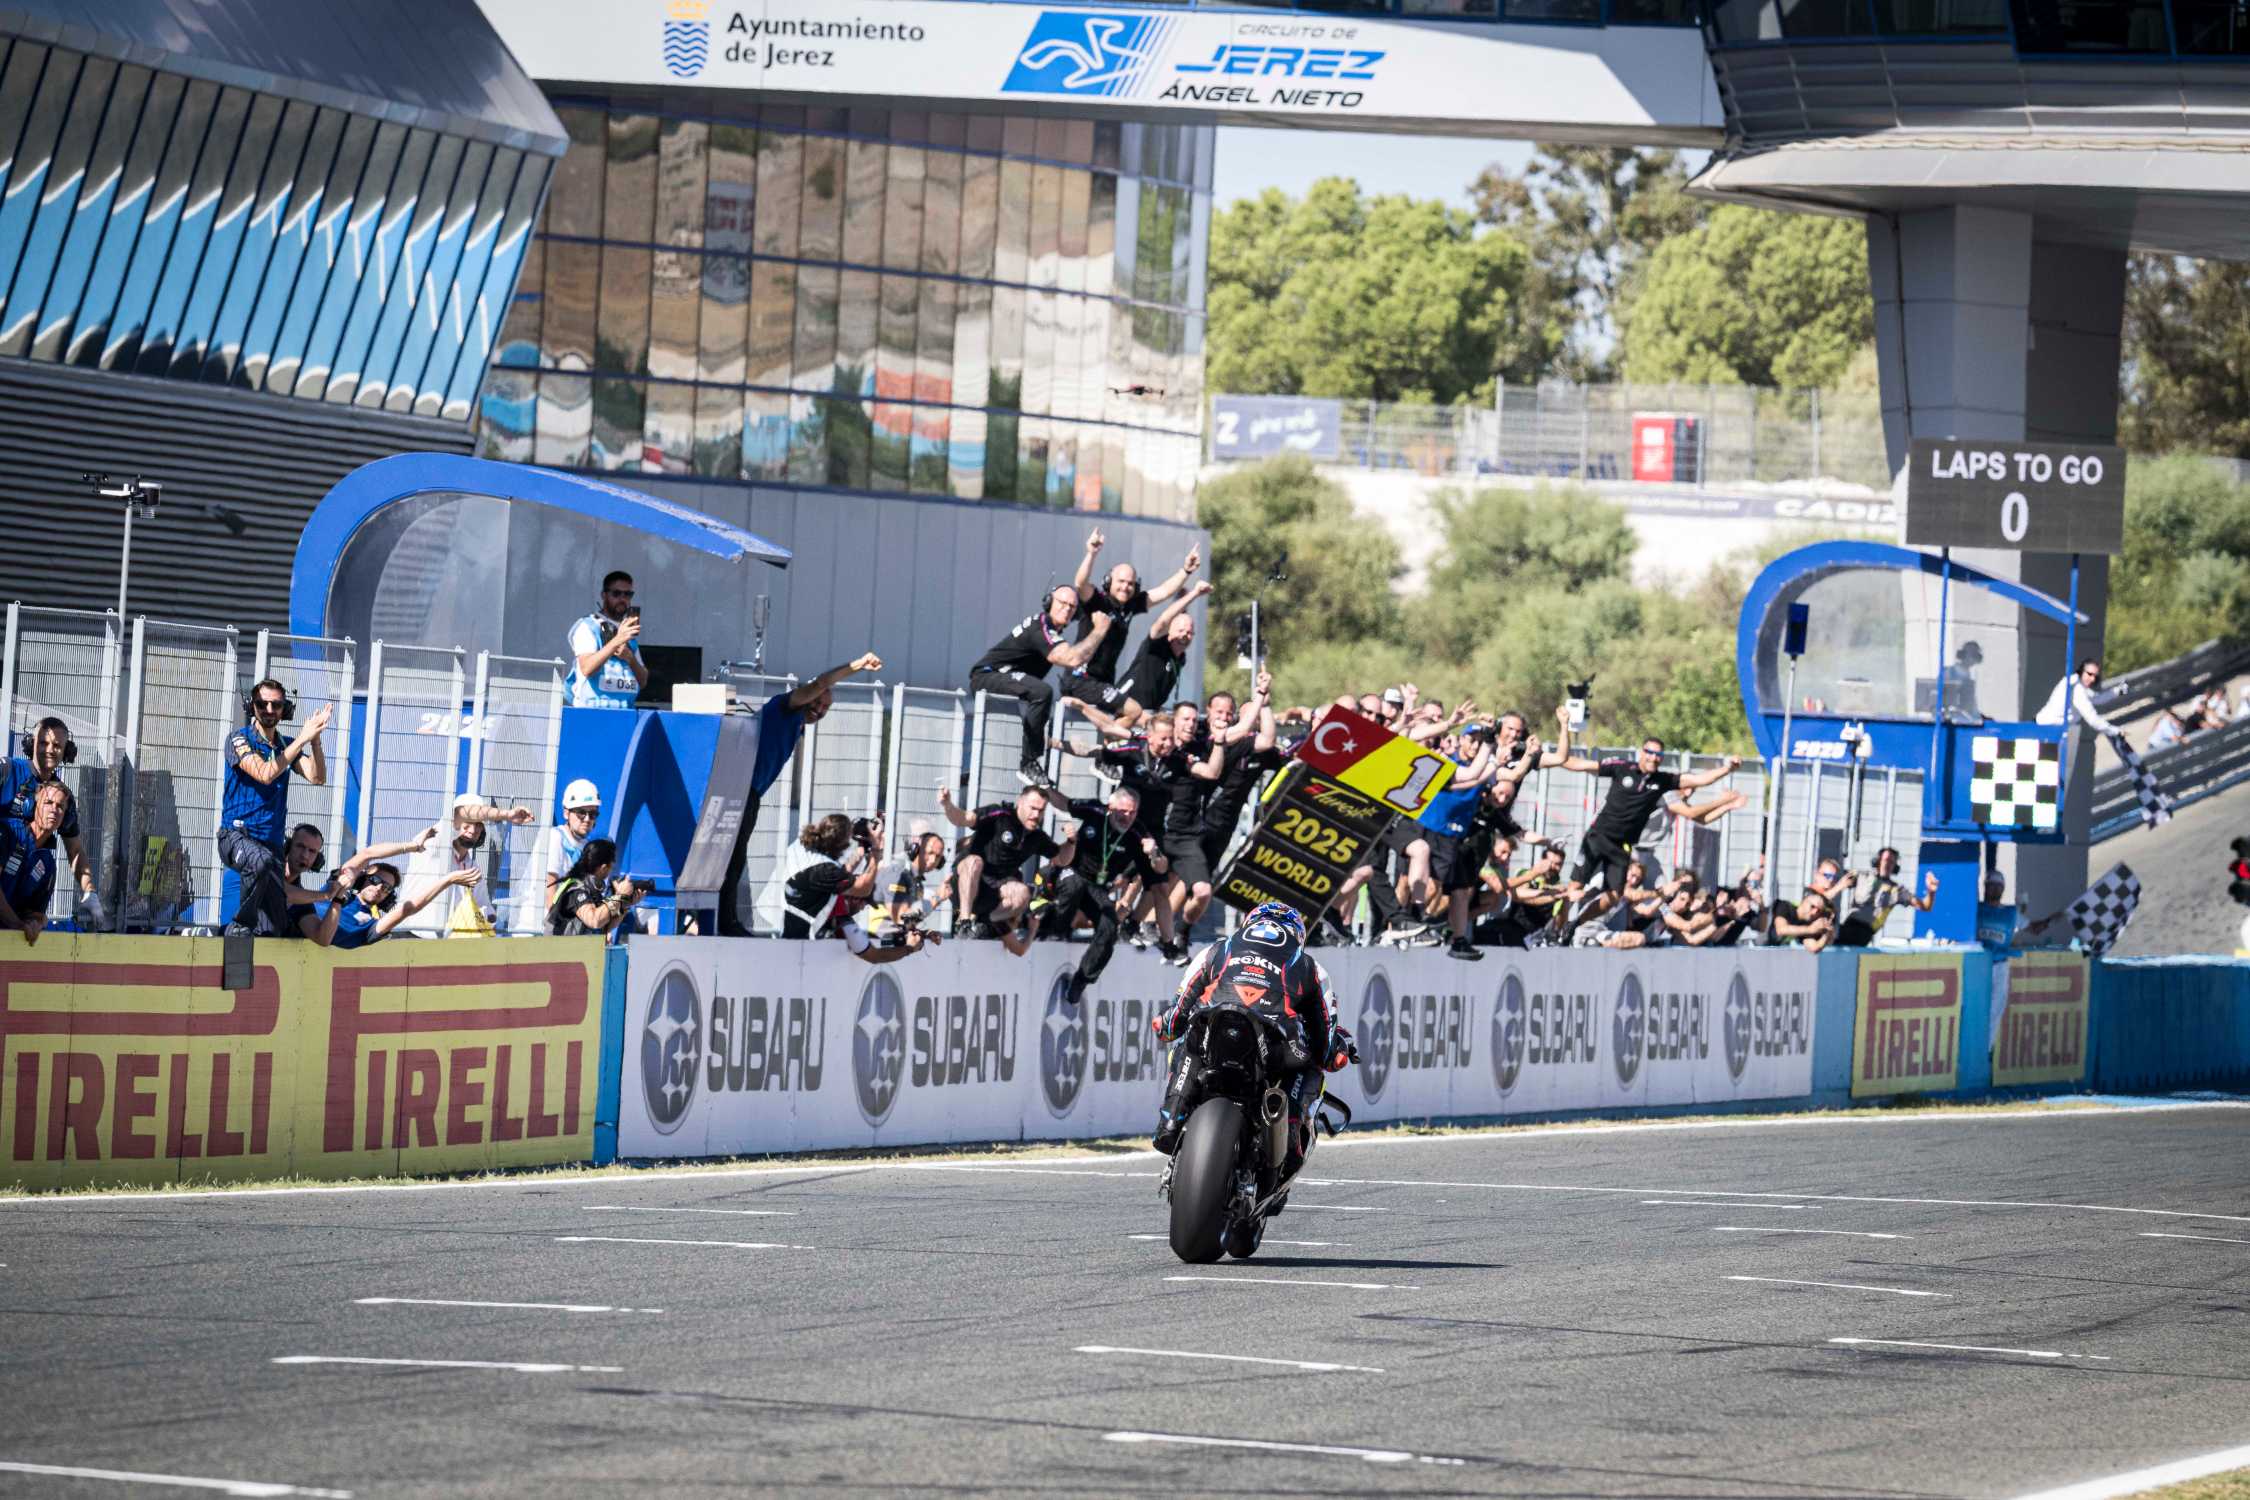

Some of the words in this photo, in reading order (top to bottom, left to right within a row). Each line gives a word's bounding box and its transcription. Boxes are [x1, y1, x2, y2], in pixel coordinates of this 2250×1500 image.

[725, 42, 757, 63] de
[764, 43, 835, 69] Jerez
[728, 13, 925, 41] Ayuntamiento
[1238, 23, 1325, 39] CIRCUITO
[1331, 26, 1359, 40] DE
[1175, 44, 1387, 79] JEREZ
[1160, 79, 1260, 103] ÁNGEL
[1271, 88, 1364, 107] NIETO
[1932, 449, 2007, 480] LAPS
[2013, 452, 2052, 482] TO
[2059, 455, 2103, 485] GO
[2001, 491, 2029, 542] 0
[1383, 753, 1446, 812] 1
[1274, 808, 1358, 864] 2025
[1253, 845, 1331, 894] WORLD
[707, 996, 827, 1092] SUBARU
[911, 993, 1019, 1087] SUBARU
[1398, 995, 1475, 1069] SUBARU
[1529, 993, 1598, 1064] SUBARU
[1647, 993, 1710, 1060] SUBARU
[1754, 991, 1812, 1057] SUBARU
[1862, 968, 1958, 1080] PIRELLI
[1999, 965, 2084, 1071] PIRELLI
[0, 961, 281, 1161] PIRELLI
[323, 961, 589, 1153] PIRELLI
